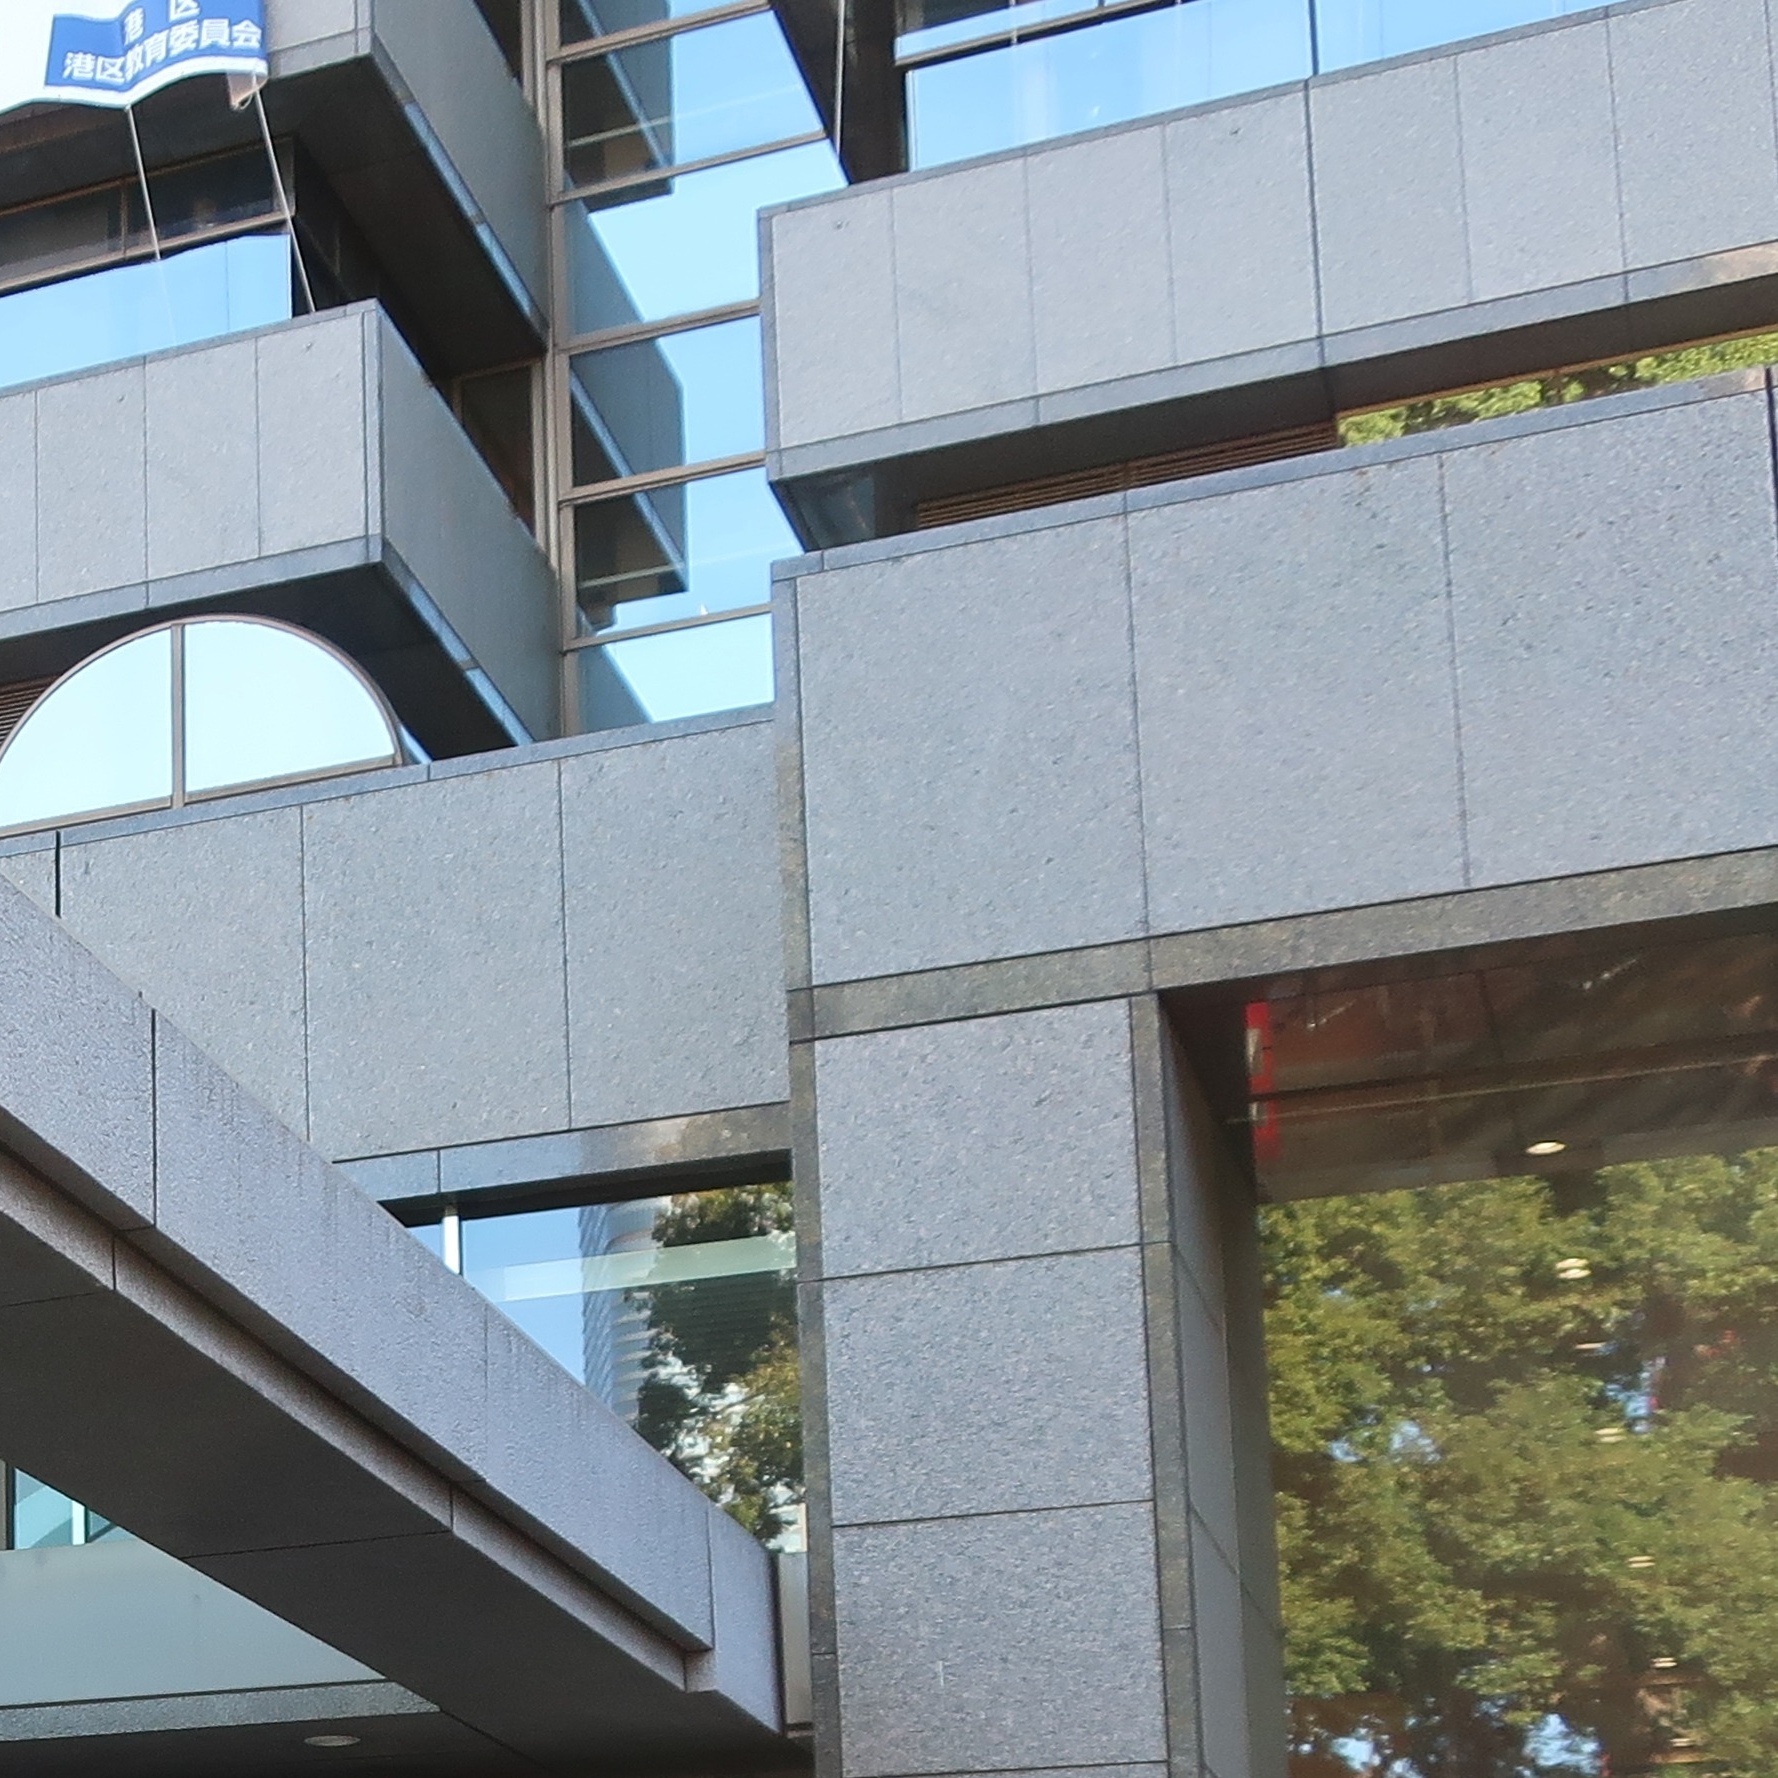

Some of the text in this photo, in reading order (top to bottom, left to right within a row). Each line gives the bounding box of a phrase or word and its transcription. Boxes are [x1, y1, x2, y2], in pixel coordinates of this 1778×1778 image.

[63, 19, 263, 84] 港区教育委員会
